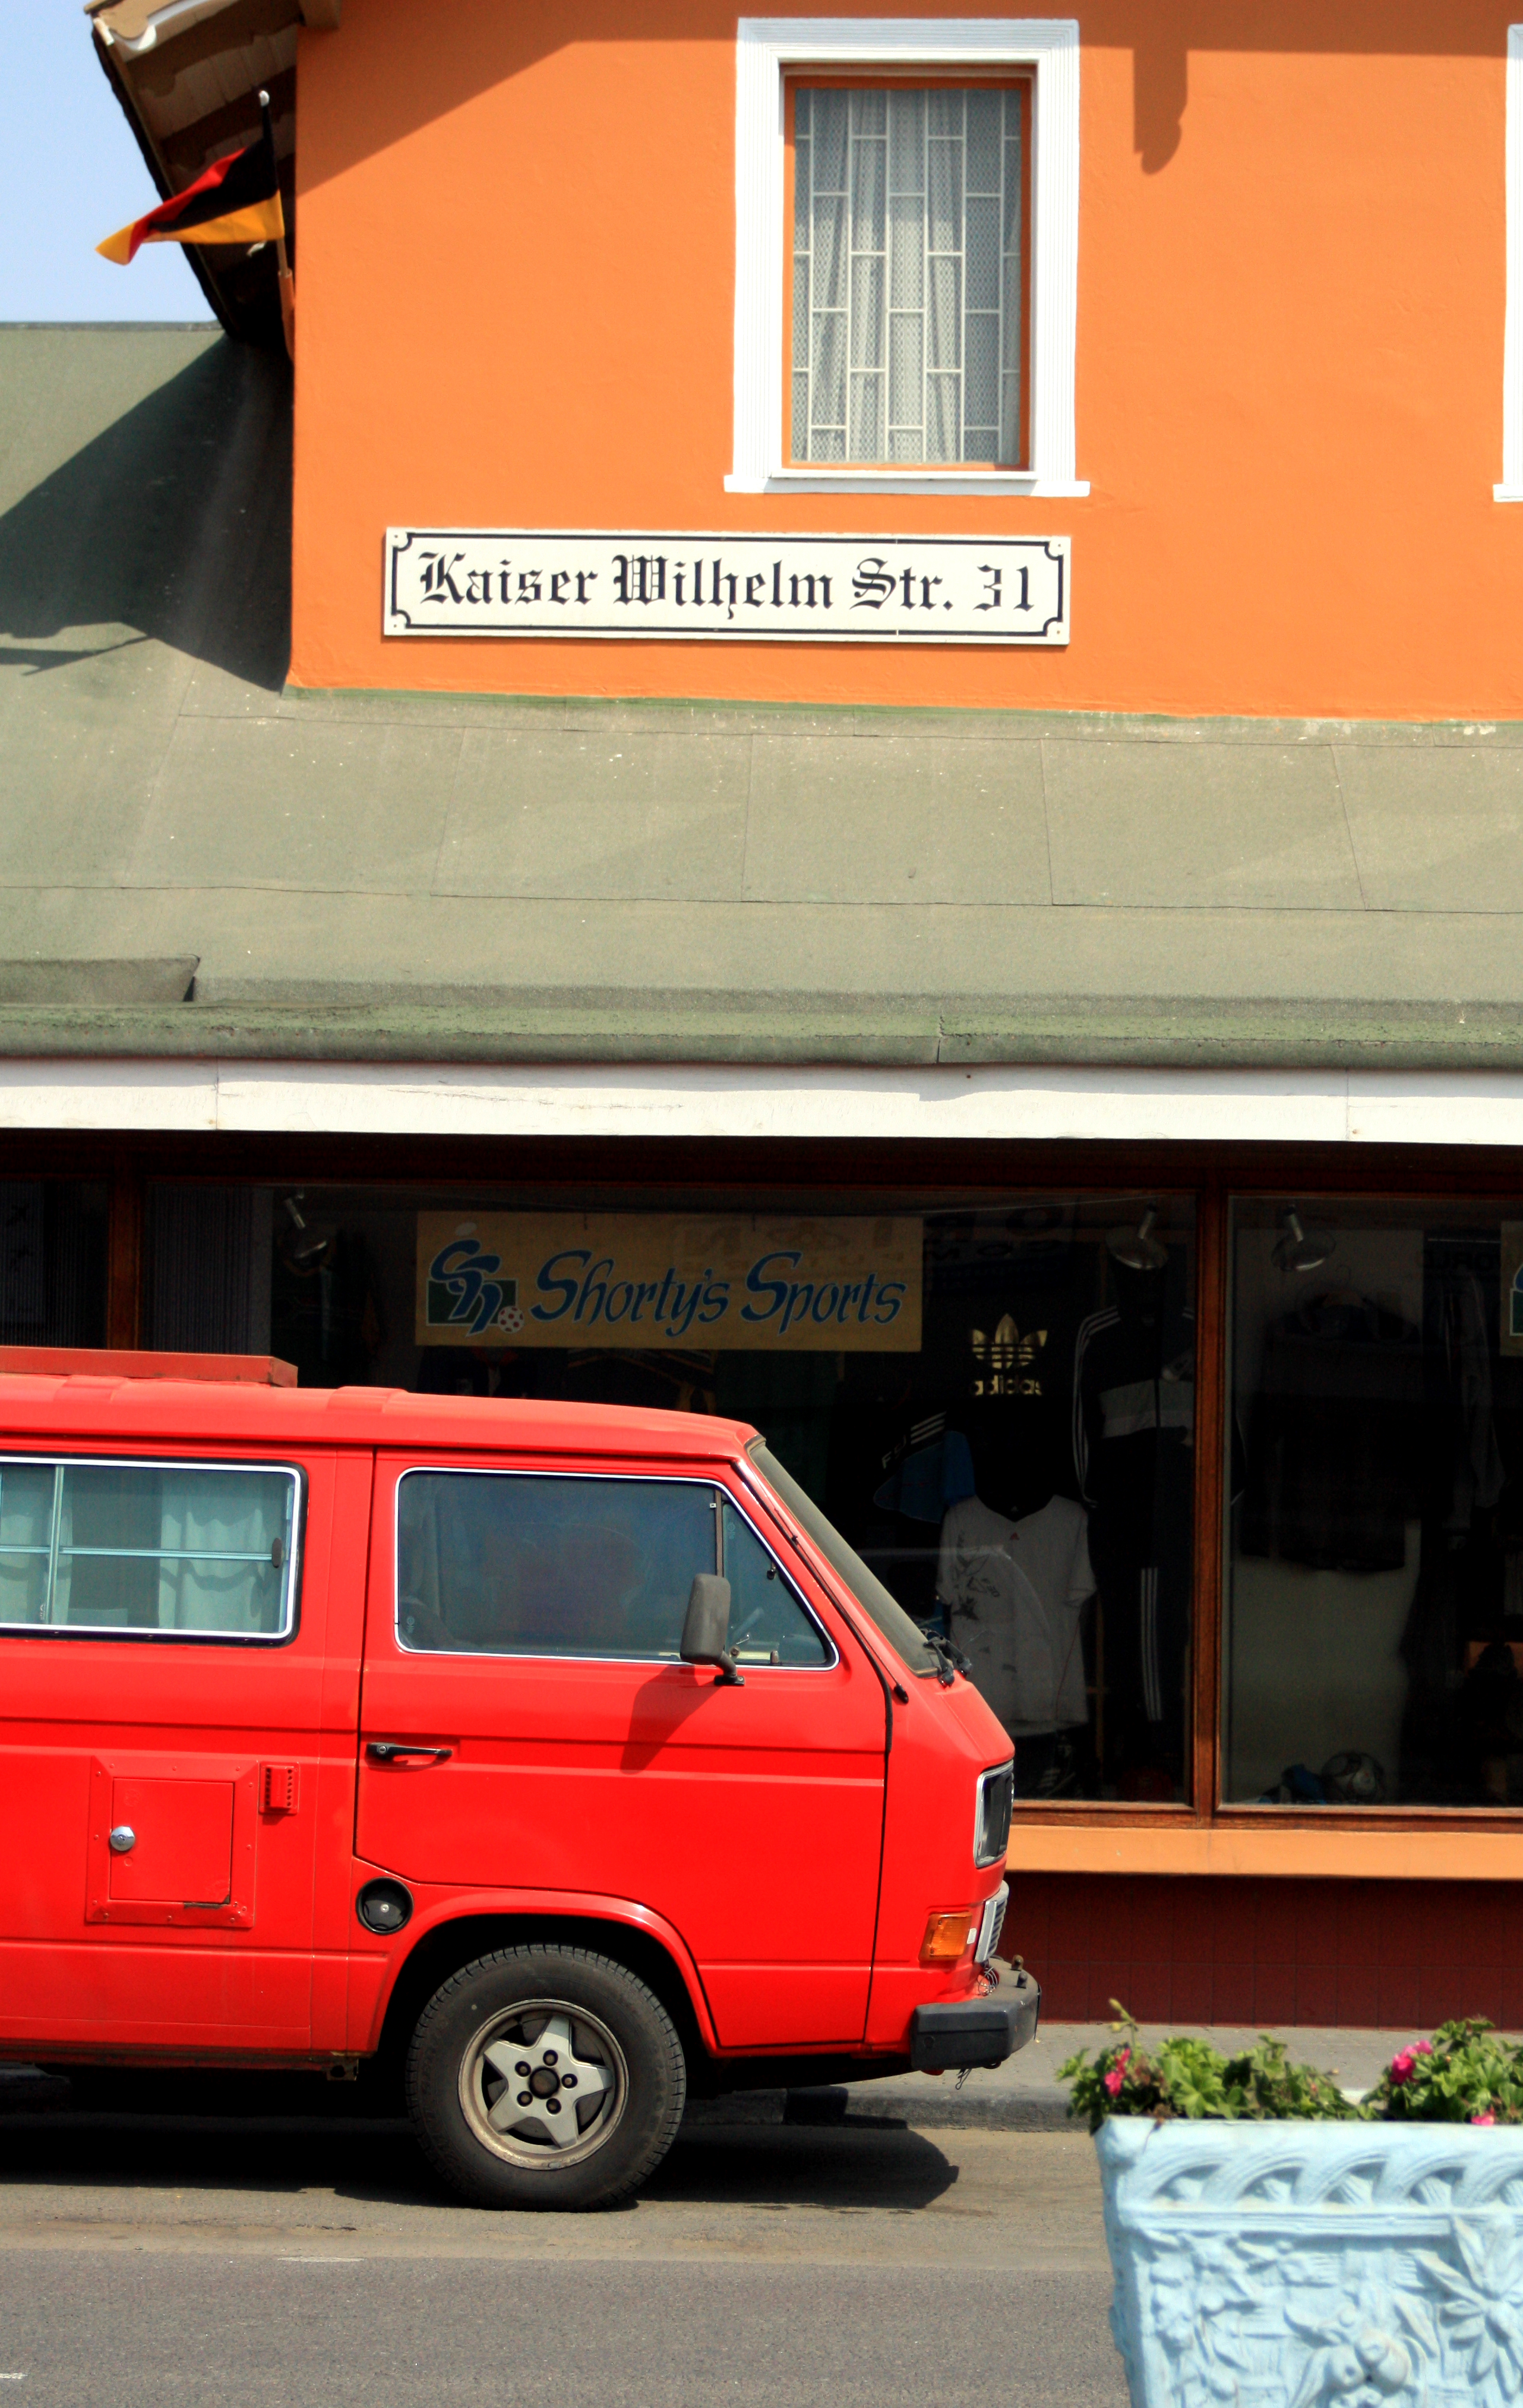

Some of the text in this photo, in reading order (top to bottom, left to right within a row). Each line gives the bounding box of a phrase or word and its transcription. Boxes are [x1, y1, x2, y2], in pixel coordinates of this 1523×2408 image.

[419, 551, 1034, 620] Kaiser Wilhelm Str. 31
[530, 1249, 908, 1338] Shorty's Sports
[971, 1374, 1043, 1397] adidas
